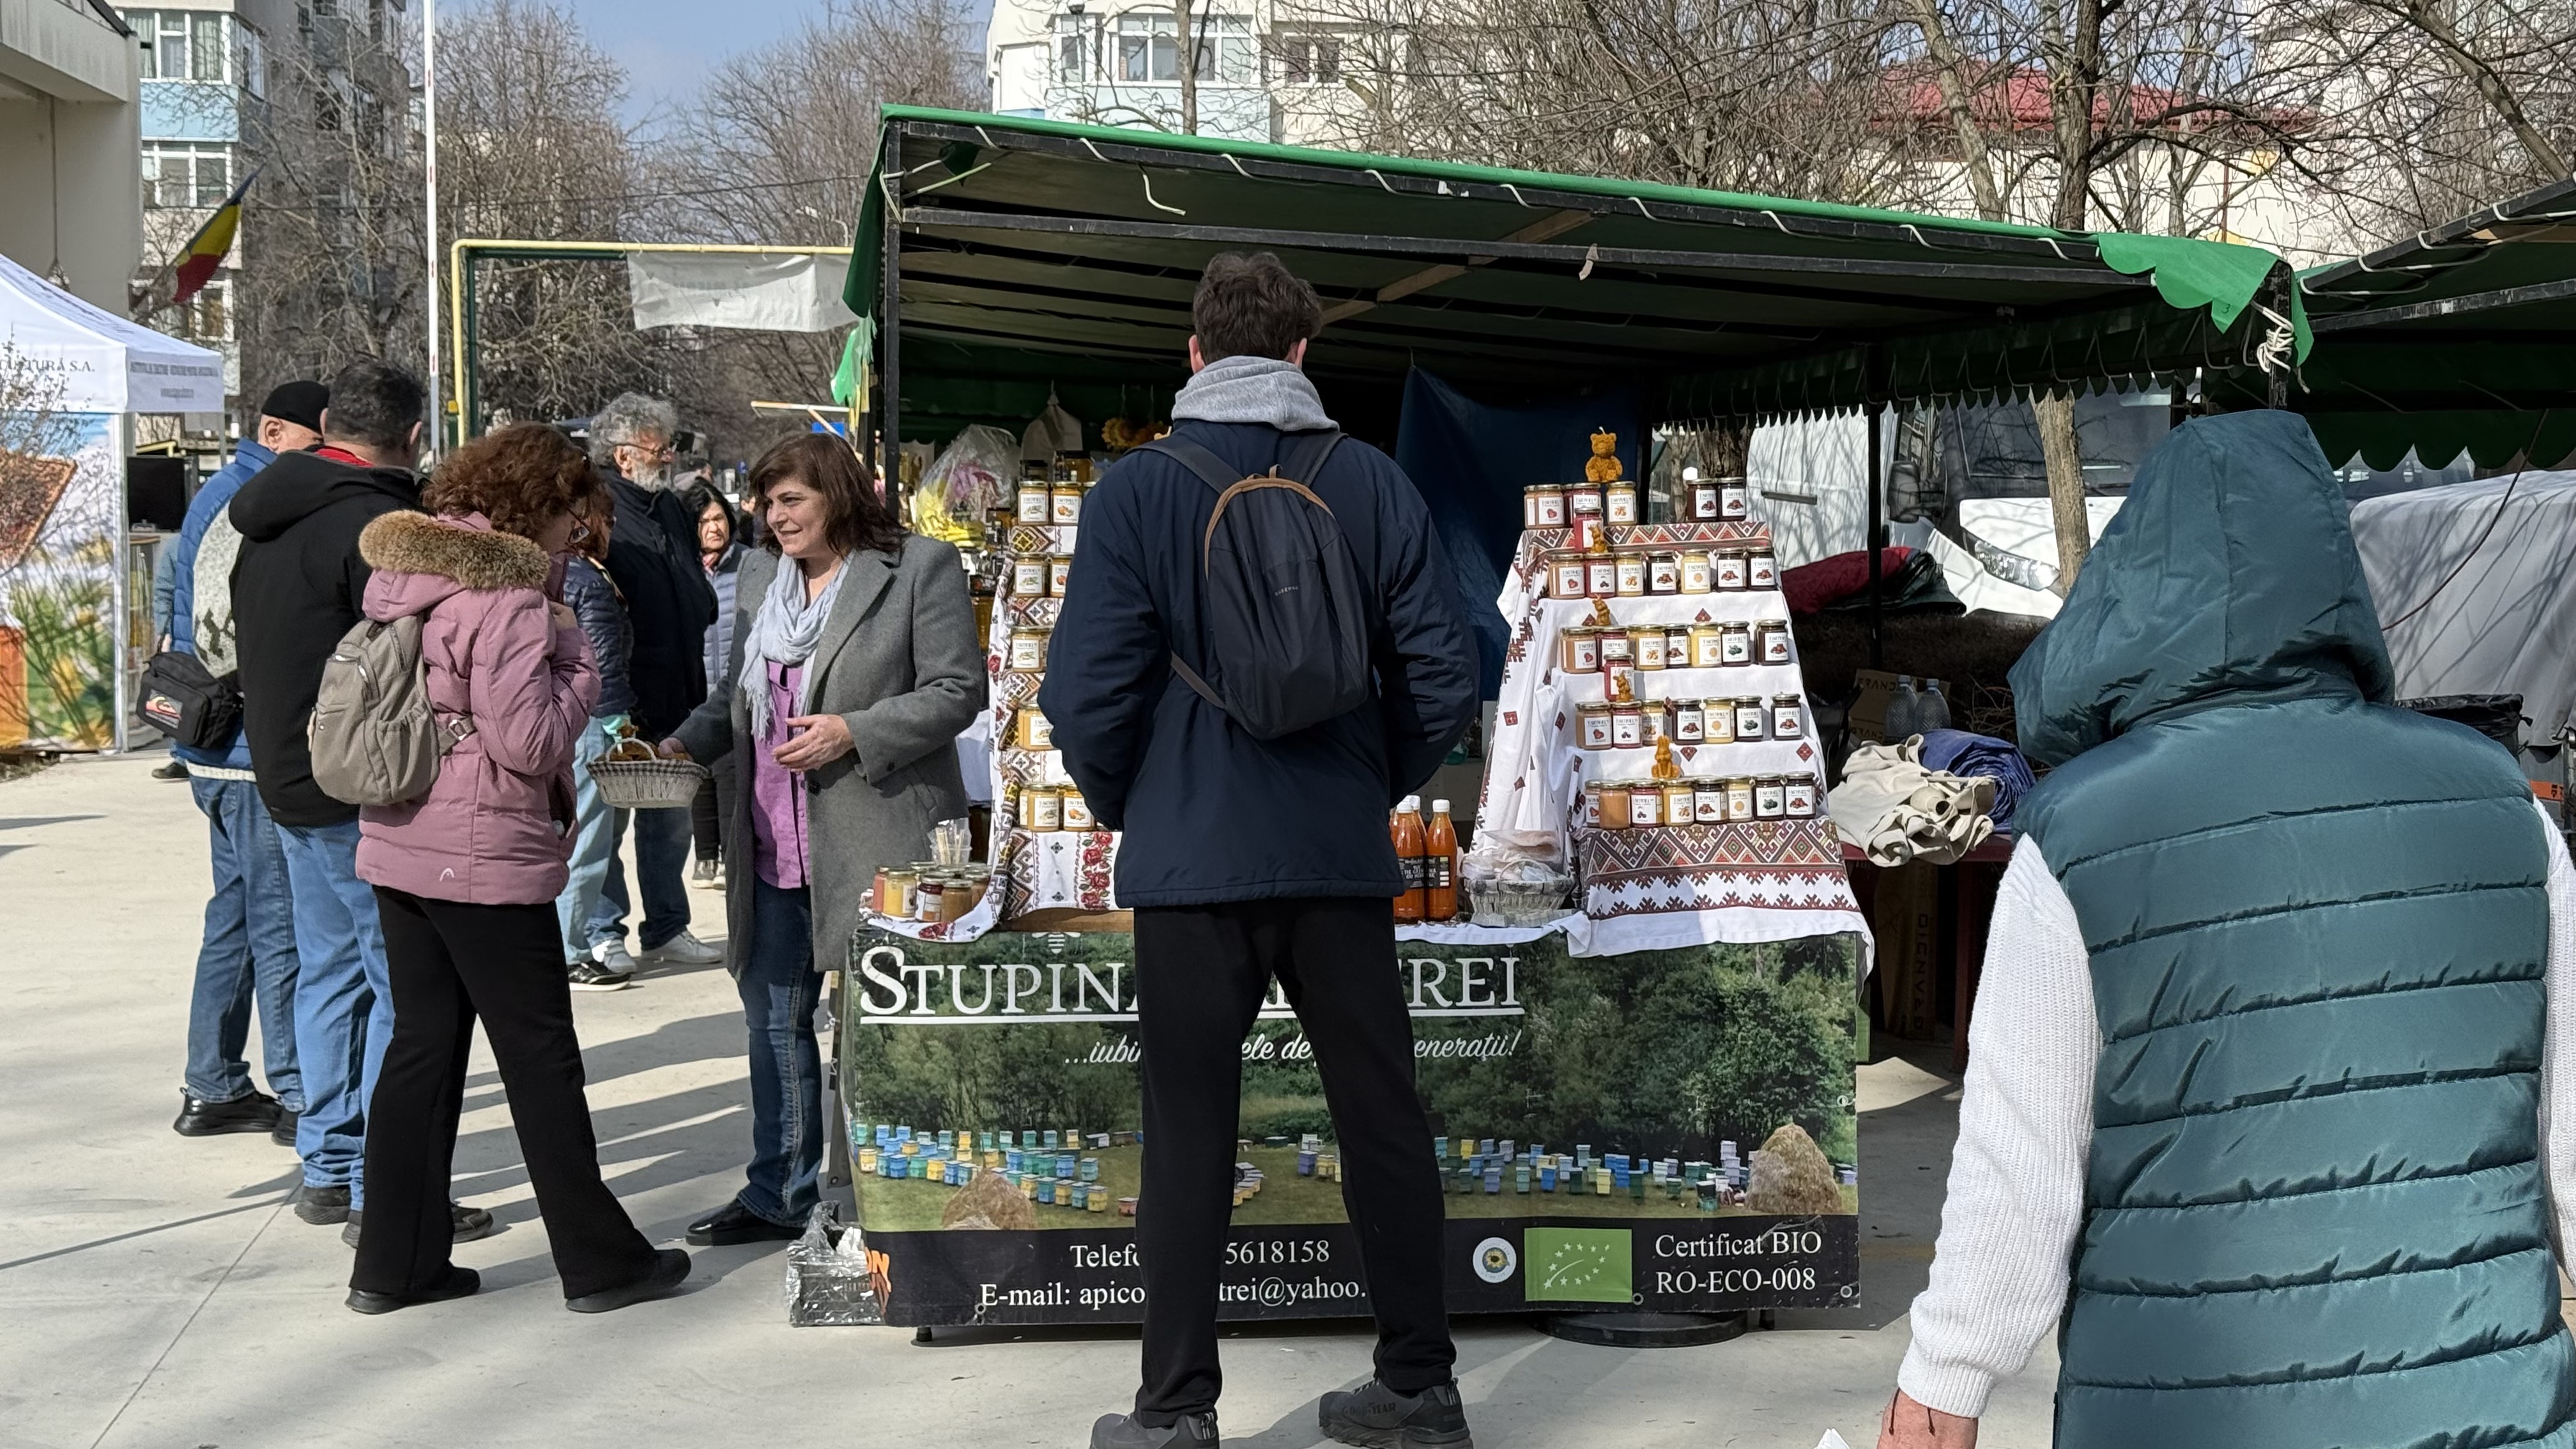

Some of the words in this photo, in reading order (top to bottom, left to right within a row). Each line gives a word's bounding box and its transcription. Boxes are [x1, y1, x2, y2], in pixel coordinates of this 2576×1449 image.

[69, 360, 95, 372] S.A.
[860, 946, 1138, 1015] STUPIN
[1414, 1029, 1522, 1061] enerații!
[1225, 1240, 1330, 1264] 5618158
[1655, 1233, 1763, 1257] Certificat
[1771, 1231, 1821, 1254] BIO
[979, 1282, 1070, 1306] E-mail:
[1655, 1268, 1816, 1294] RO-ECO-008
